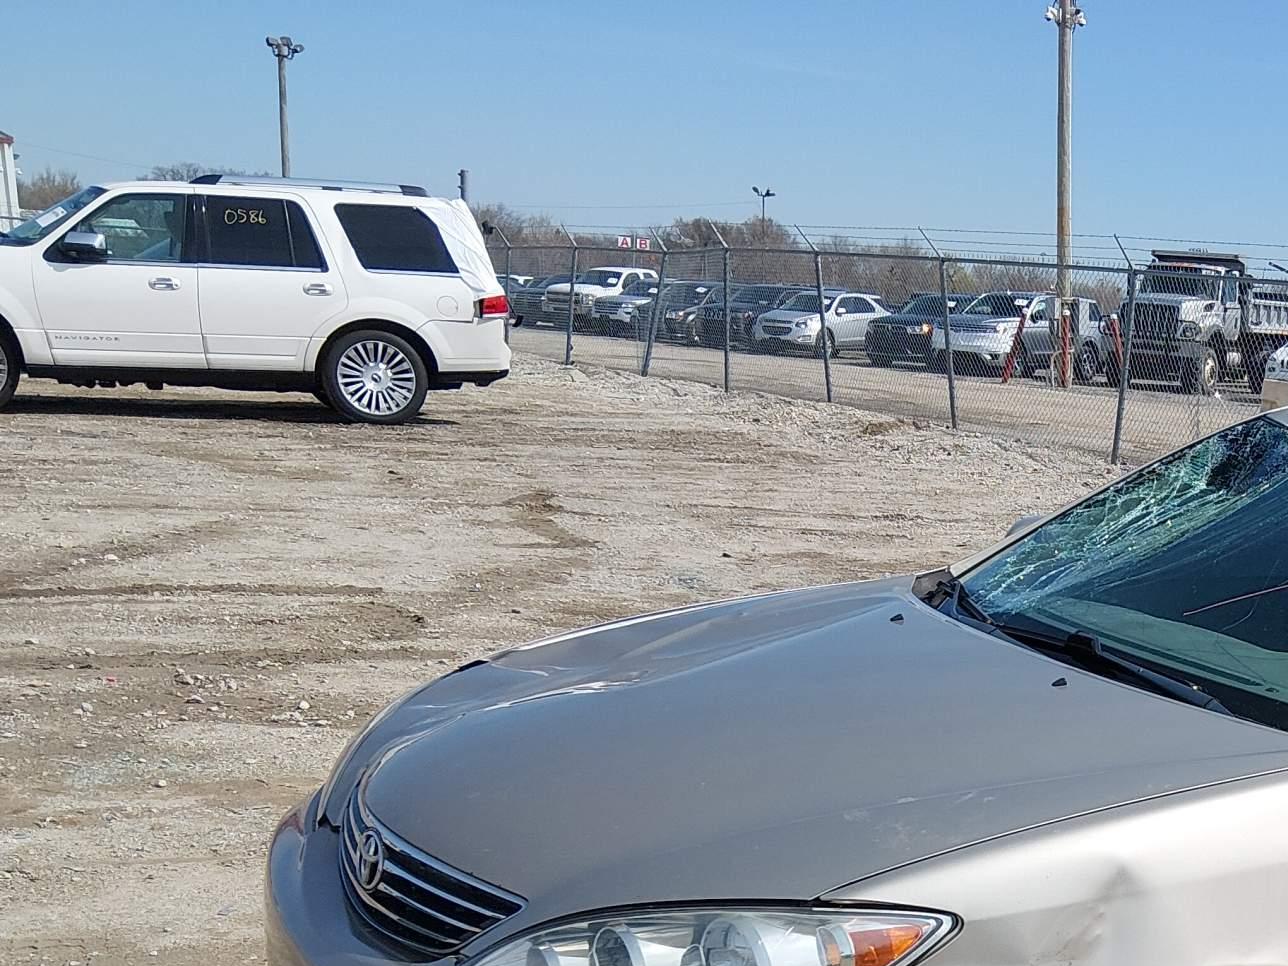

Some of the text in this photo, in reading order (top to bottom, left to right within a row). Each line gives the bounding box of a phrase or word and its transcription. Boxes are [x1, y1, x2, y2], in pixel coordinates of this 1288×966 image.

[224, 208, 267, 225] 0586
[620, 237, 648, 249] A B
[54, 334, 120, 342] NAVIGATOR
